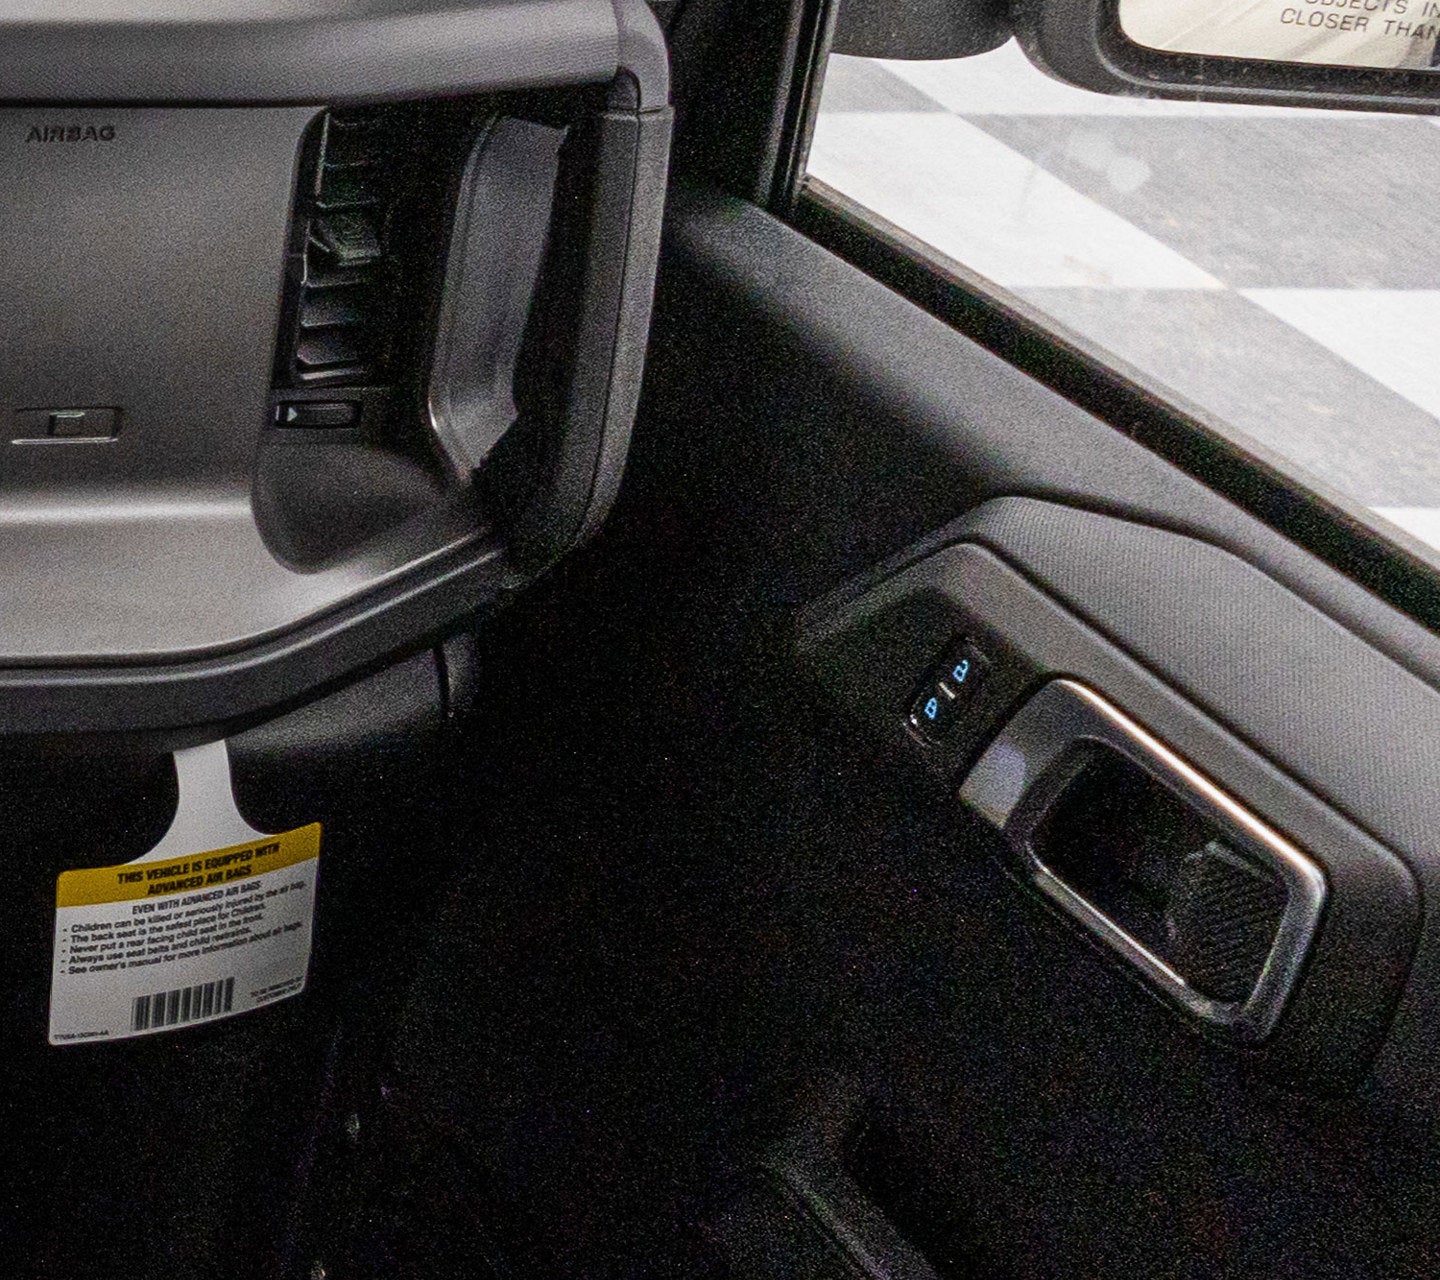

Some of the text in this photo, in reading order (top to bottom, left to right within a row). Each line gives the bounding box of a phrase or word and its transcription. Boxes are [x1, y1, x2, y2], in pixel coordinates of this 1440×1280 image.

[1280, 7, 1370, 32] CLOSER
[24, 124, 117, 145] AIRBAG
[147, 864, 189, 880] VEHICLE
